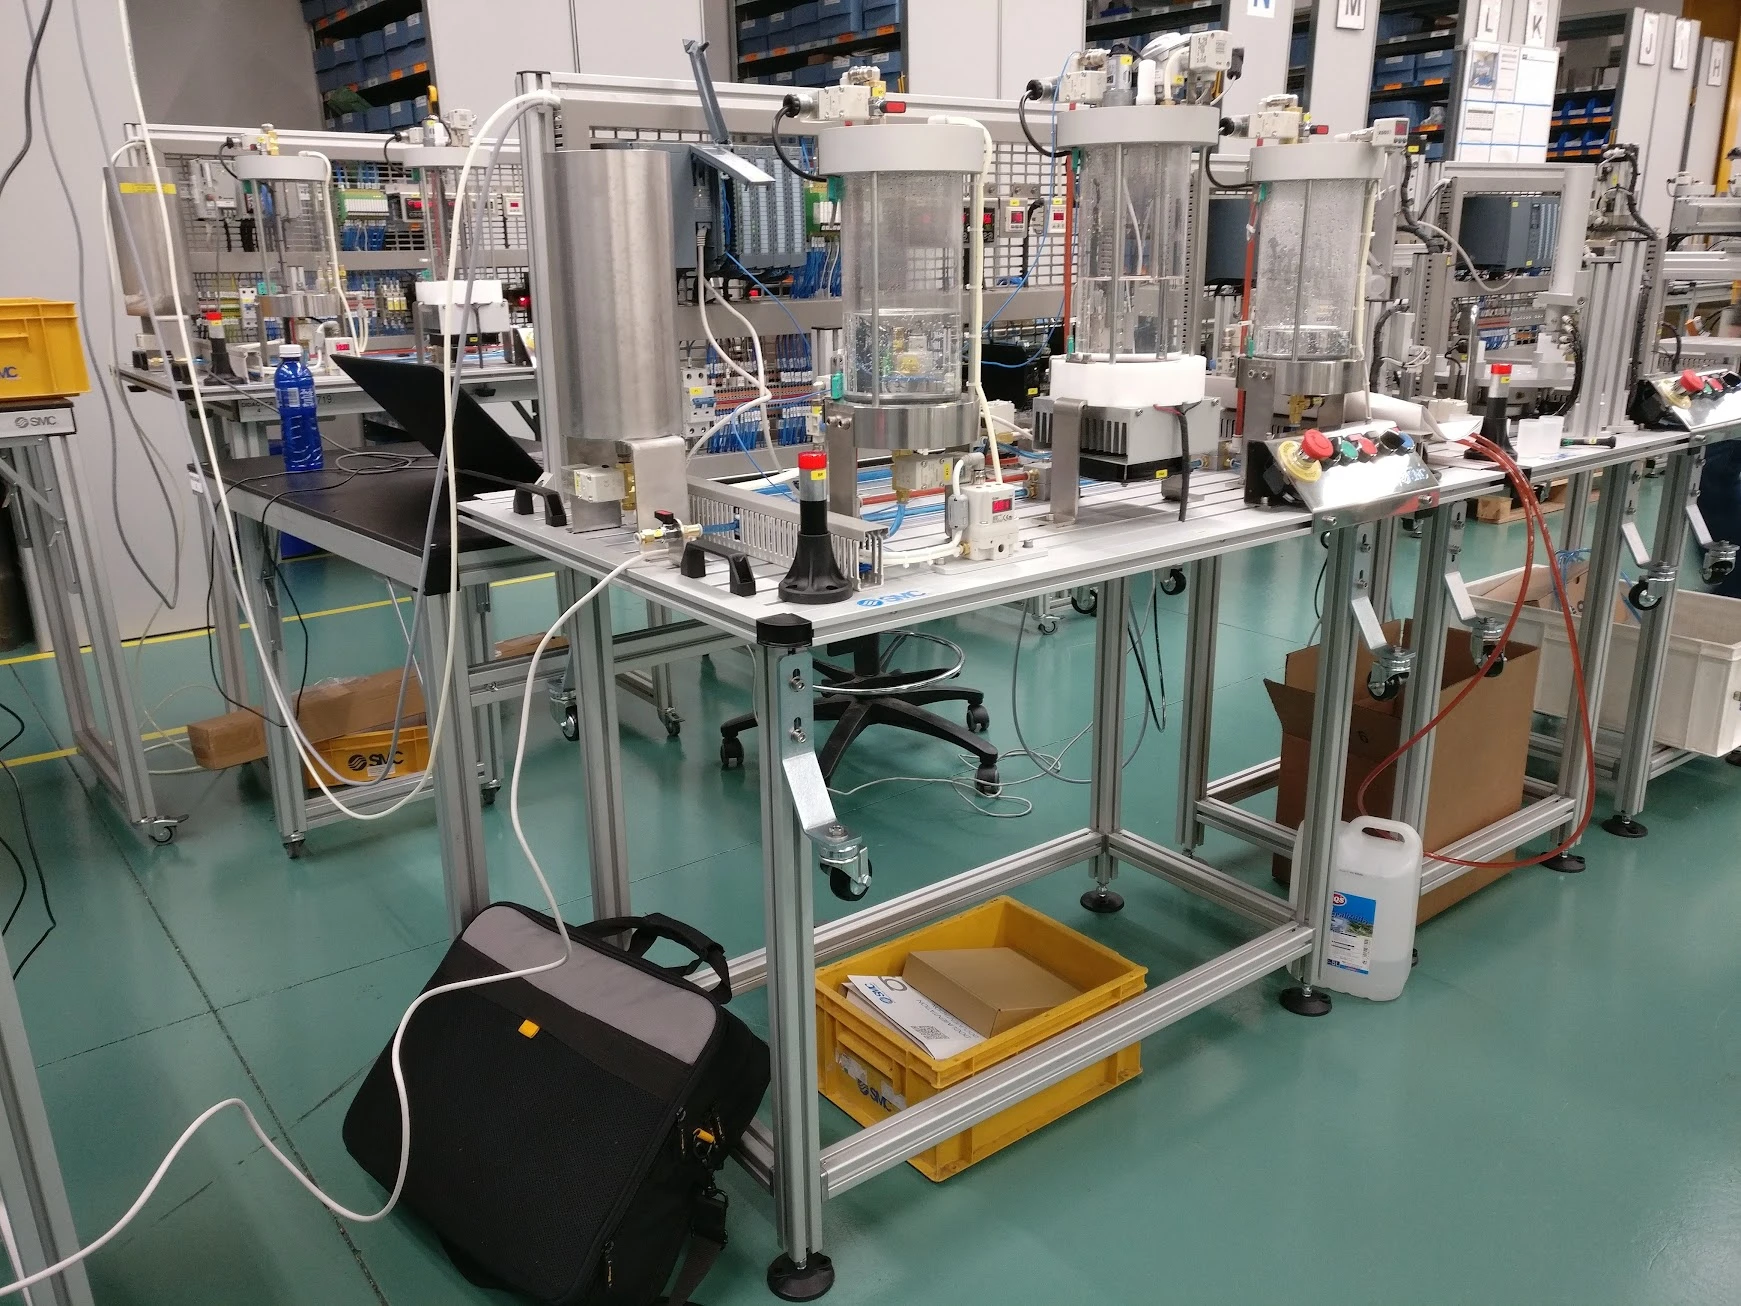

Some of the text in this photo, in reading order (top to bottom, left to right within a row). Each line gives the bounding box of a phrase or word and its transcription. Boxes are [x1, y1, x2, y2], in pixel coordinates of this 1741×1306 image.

[1345, 0, 1361, 16] M
[1485, 7, 1493, 33] L
[1532, 15, 1543, 39] K
[1645, 32, 1653, 54] J
[1712, 58, 1721, 77] H
[0, 366, 18, 379] MC
[30, 415, 57, 427] SMC
[368, 750, 404, 767] SMC
